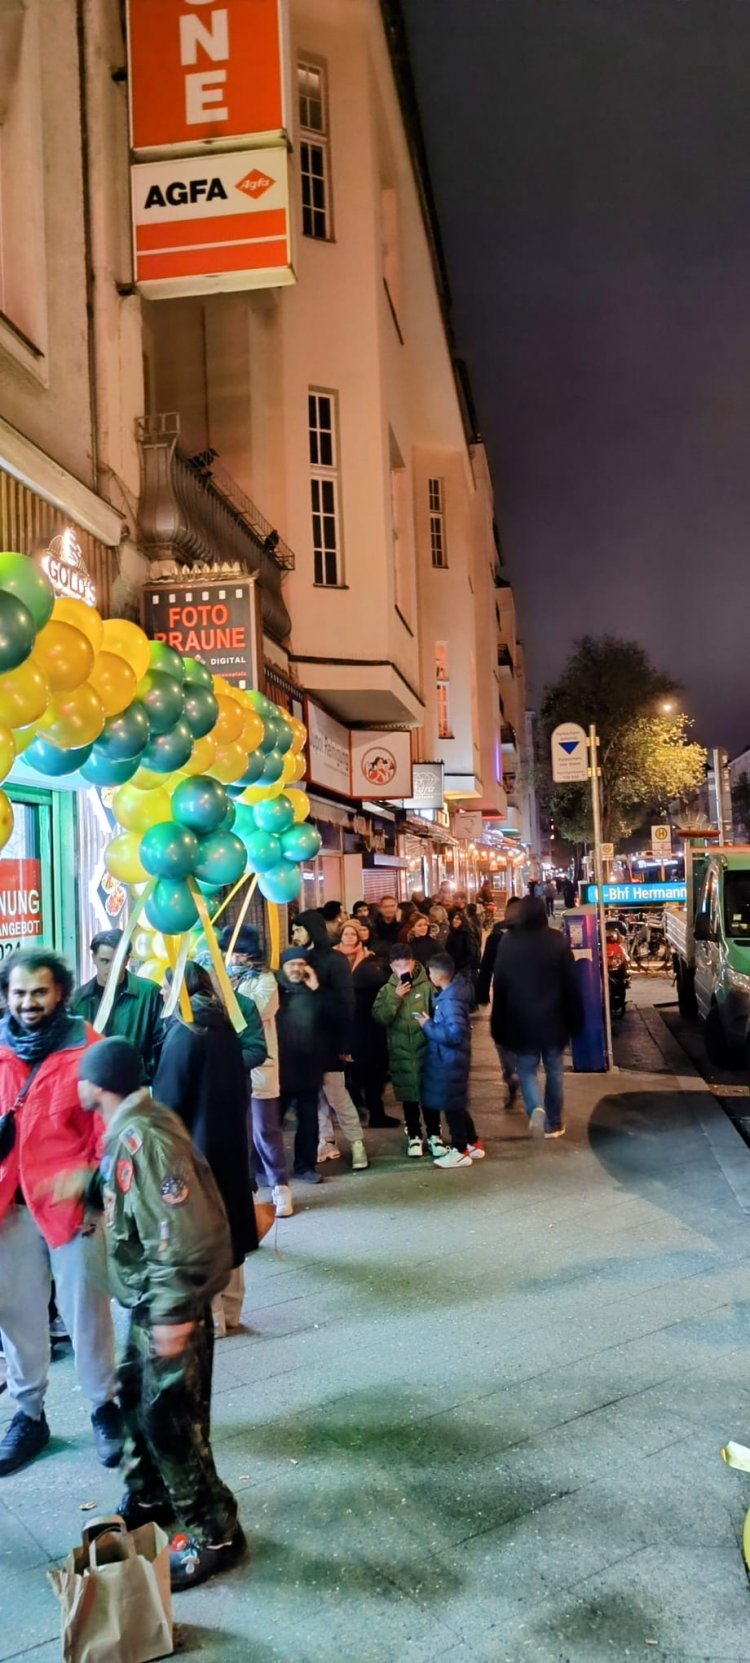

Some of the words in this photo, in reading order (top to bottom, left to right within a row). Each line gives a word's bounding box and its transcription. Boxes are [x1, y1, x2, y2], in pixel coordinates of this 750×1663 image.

[179, 0, 229, 126] NE
[144, 177, 228, 209] AGFA
[240, 176, 270, 191] Agfa
[168, 604, 229, 628] FOTO
[210, 656, 247, 666] DIGITAL
[0, 941, 20, 960] 02
